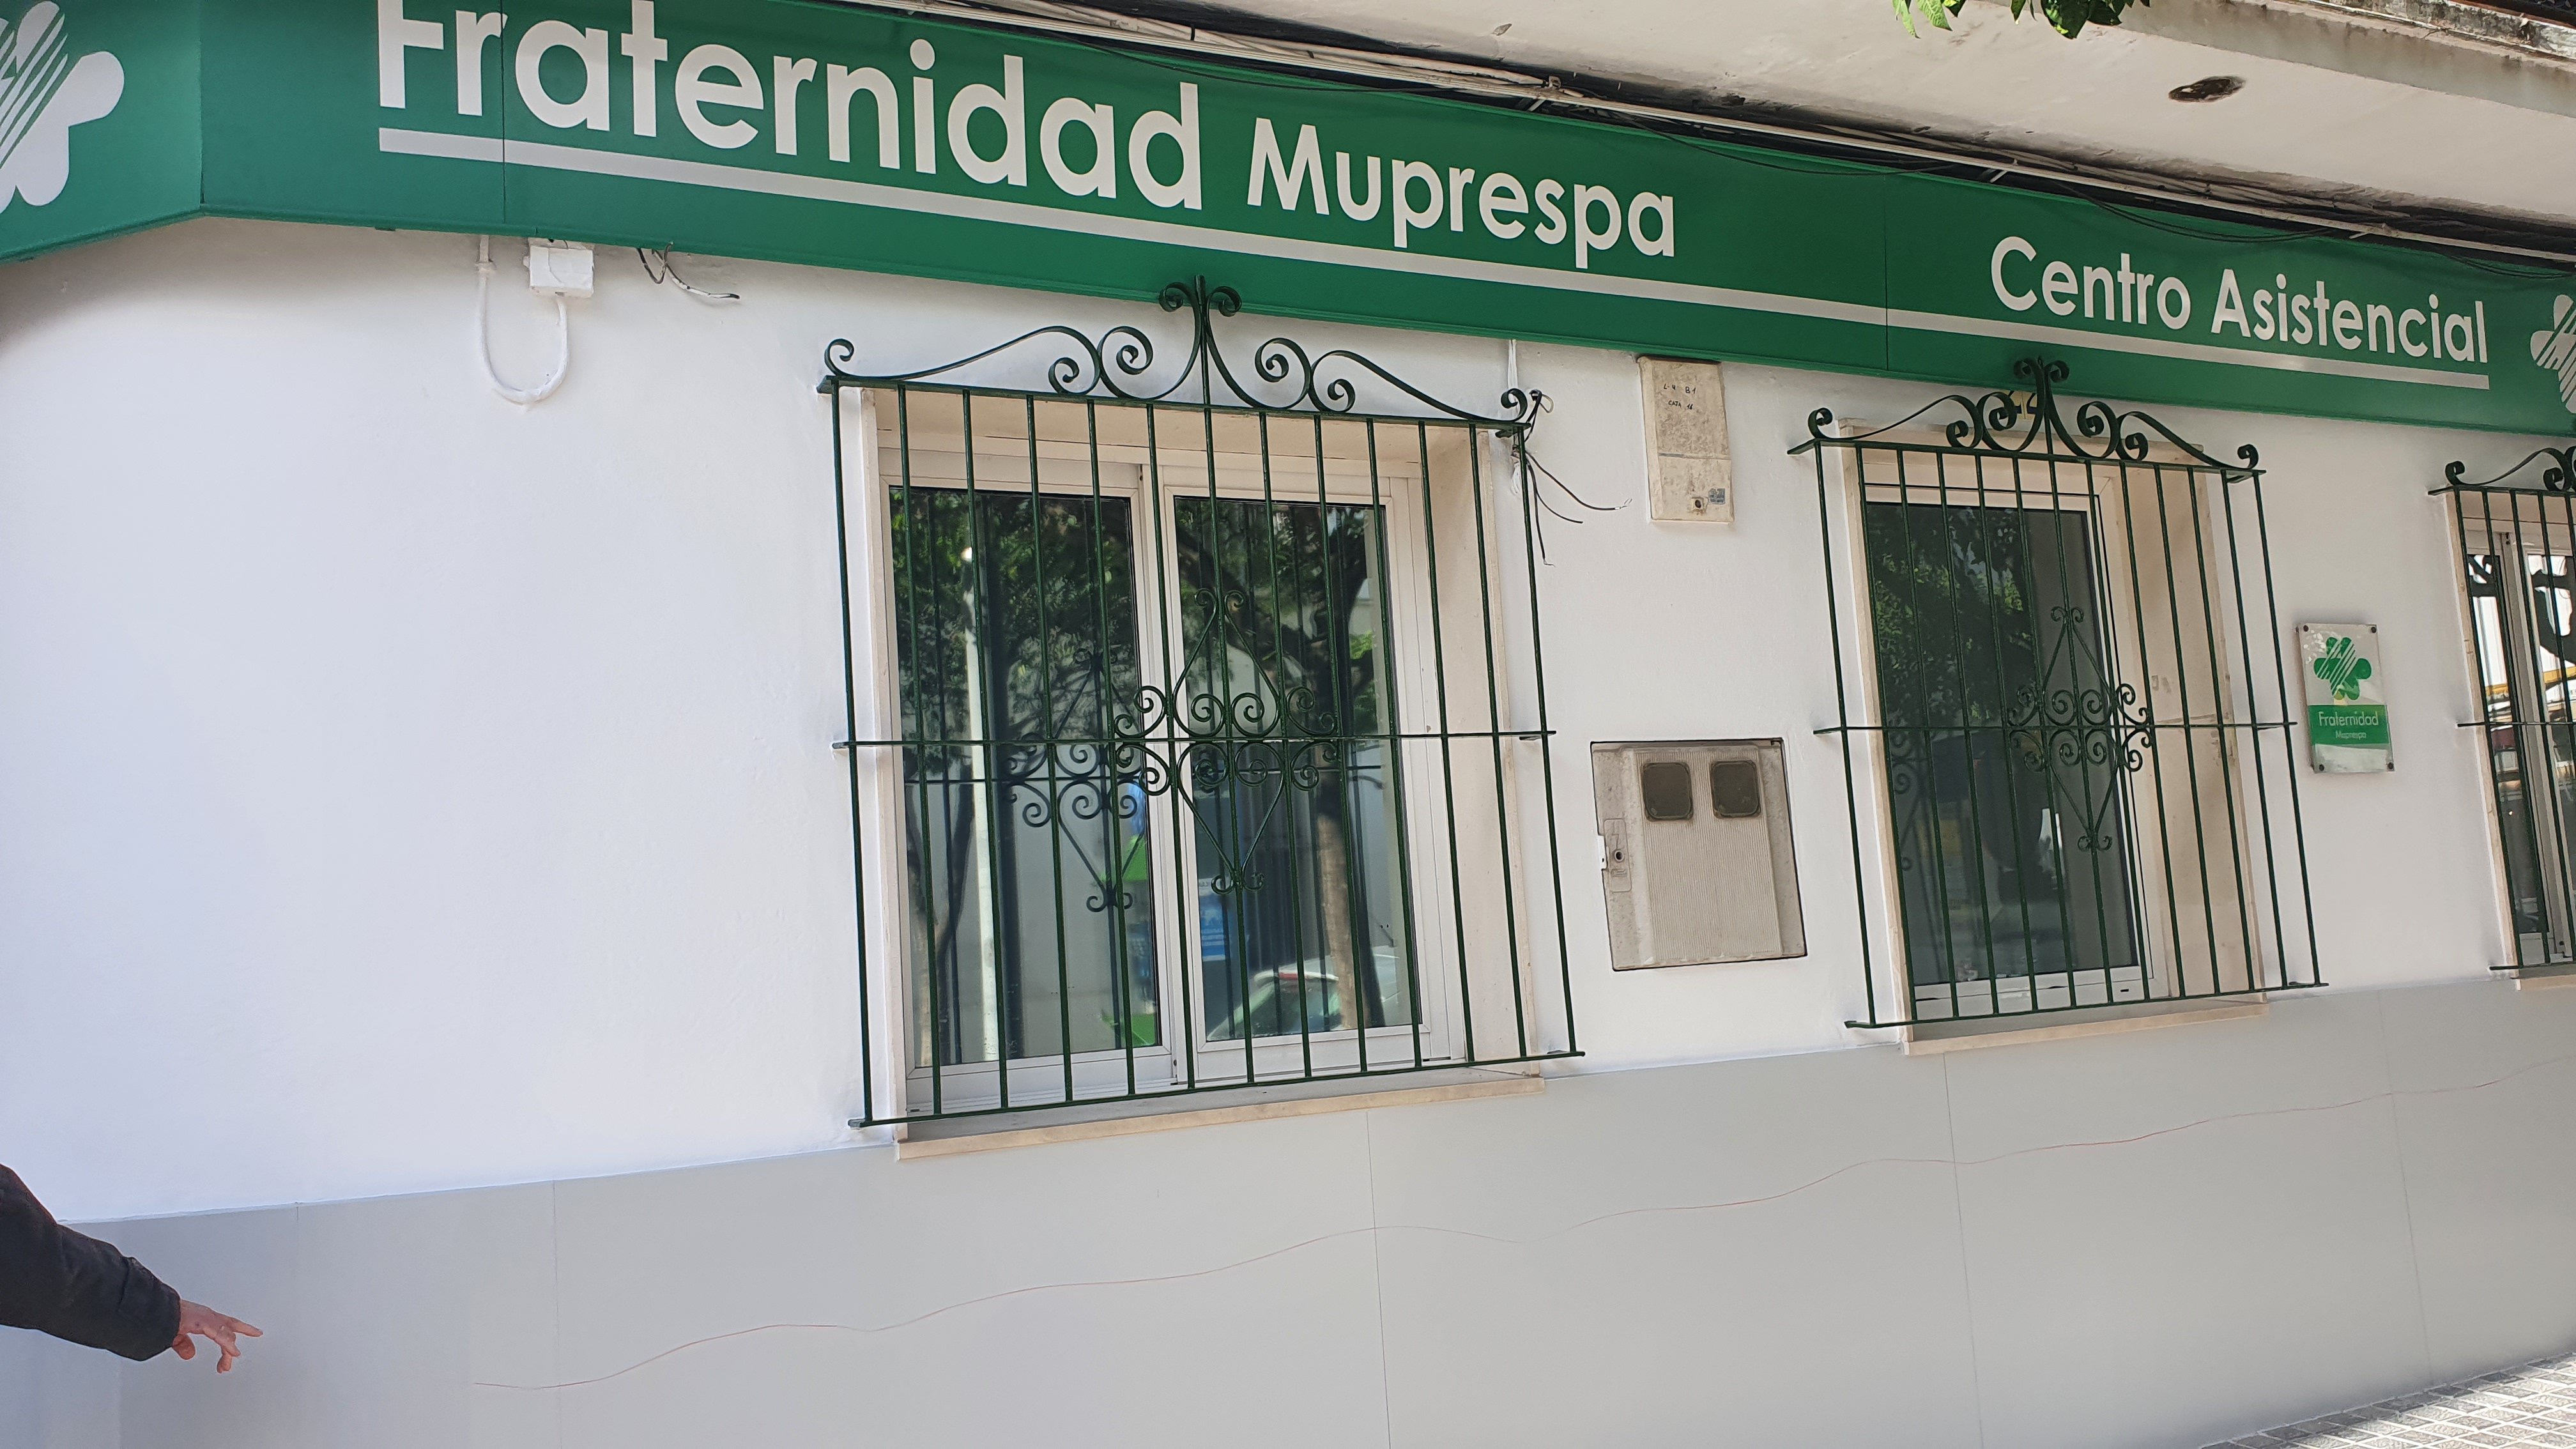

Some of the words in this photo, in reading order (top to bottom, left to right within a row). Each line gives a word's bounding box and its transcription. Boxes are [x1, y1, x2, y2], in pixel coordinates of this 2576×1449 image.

[378, 0, 1202, 210] Fraternidad
[1248, 118, 1674, 268] Muprespa
[1991, 237, 2190, 330] Centro
[2211, 269, 2488, 364] Asistencial
[2319, 710, 2379, 726] Fraternidad
